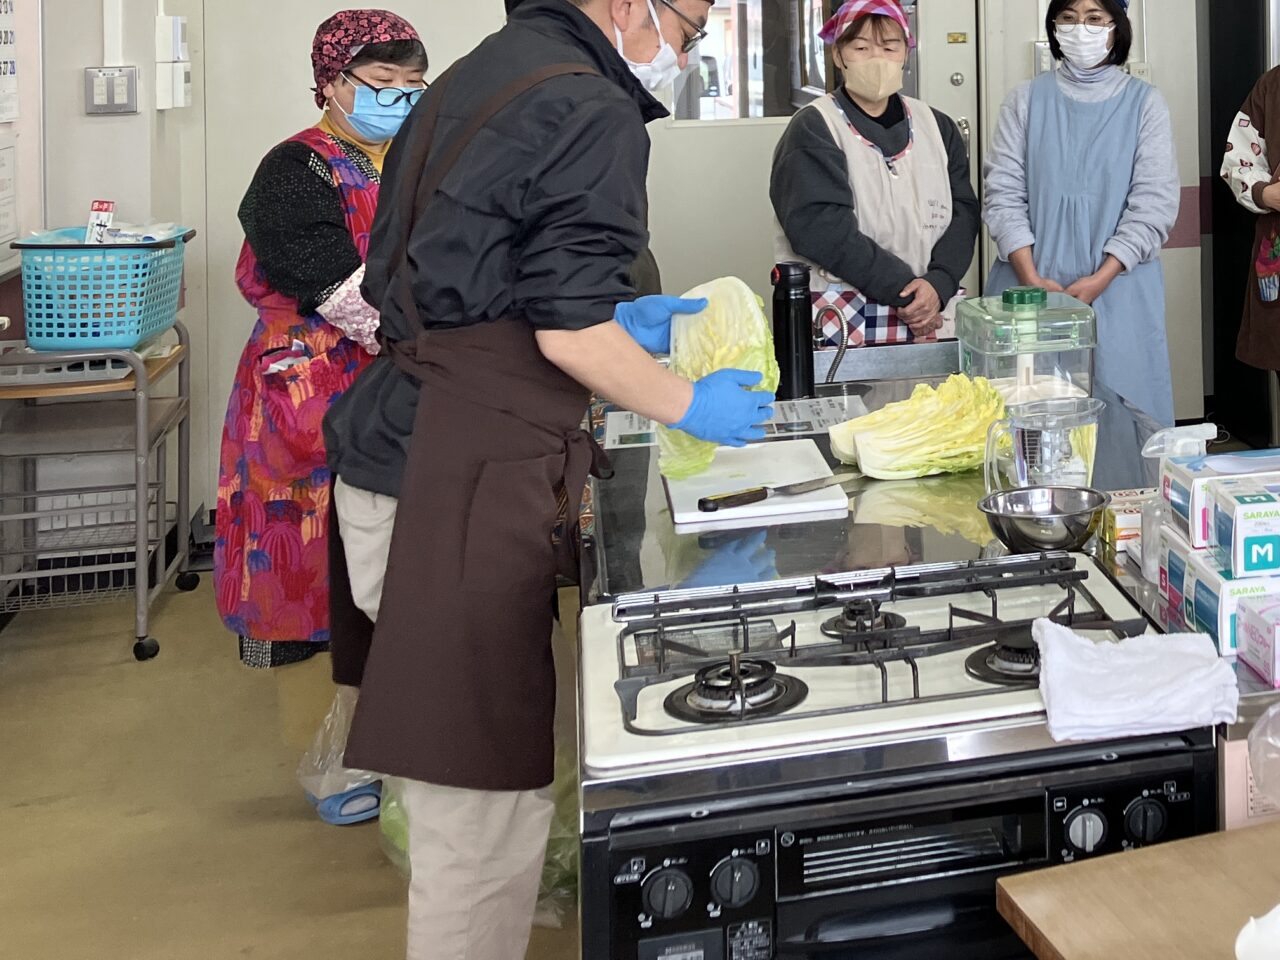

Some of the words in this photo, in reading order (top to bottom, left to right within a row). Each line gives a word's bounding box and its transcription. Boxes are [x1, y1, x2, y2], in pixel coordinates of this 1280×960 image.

[1243, 510, 1280, 520] SARAYA
[1252, 543, 1273, 564] M
[1229, 586, 1266, 596] SARAYA
